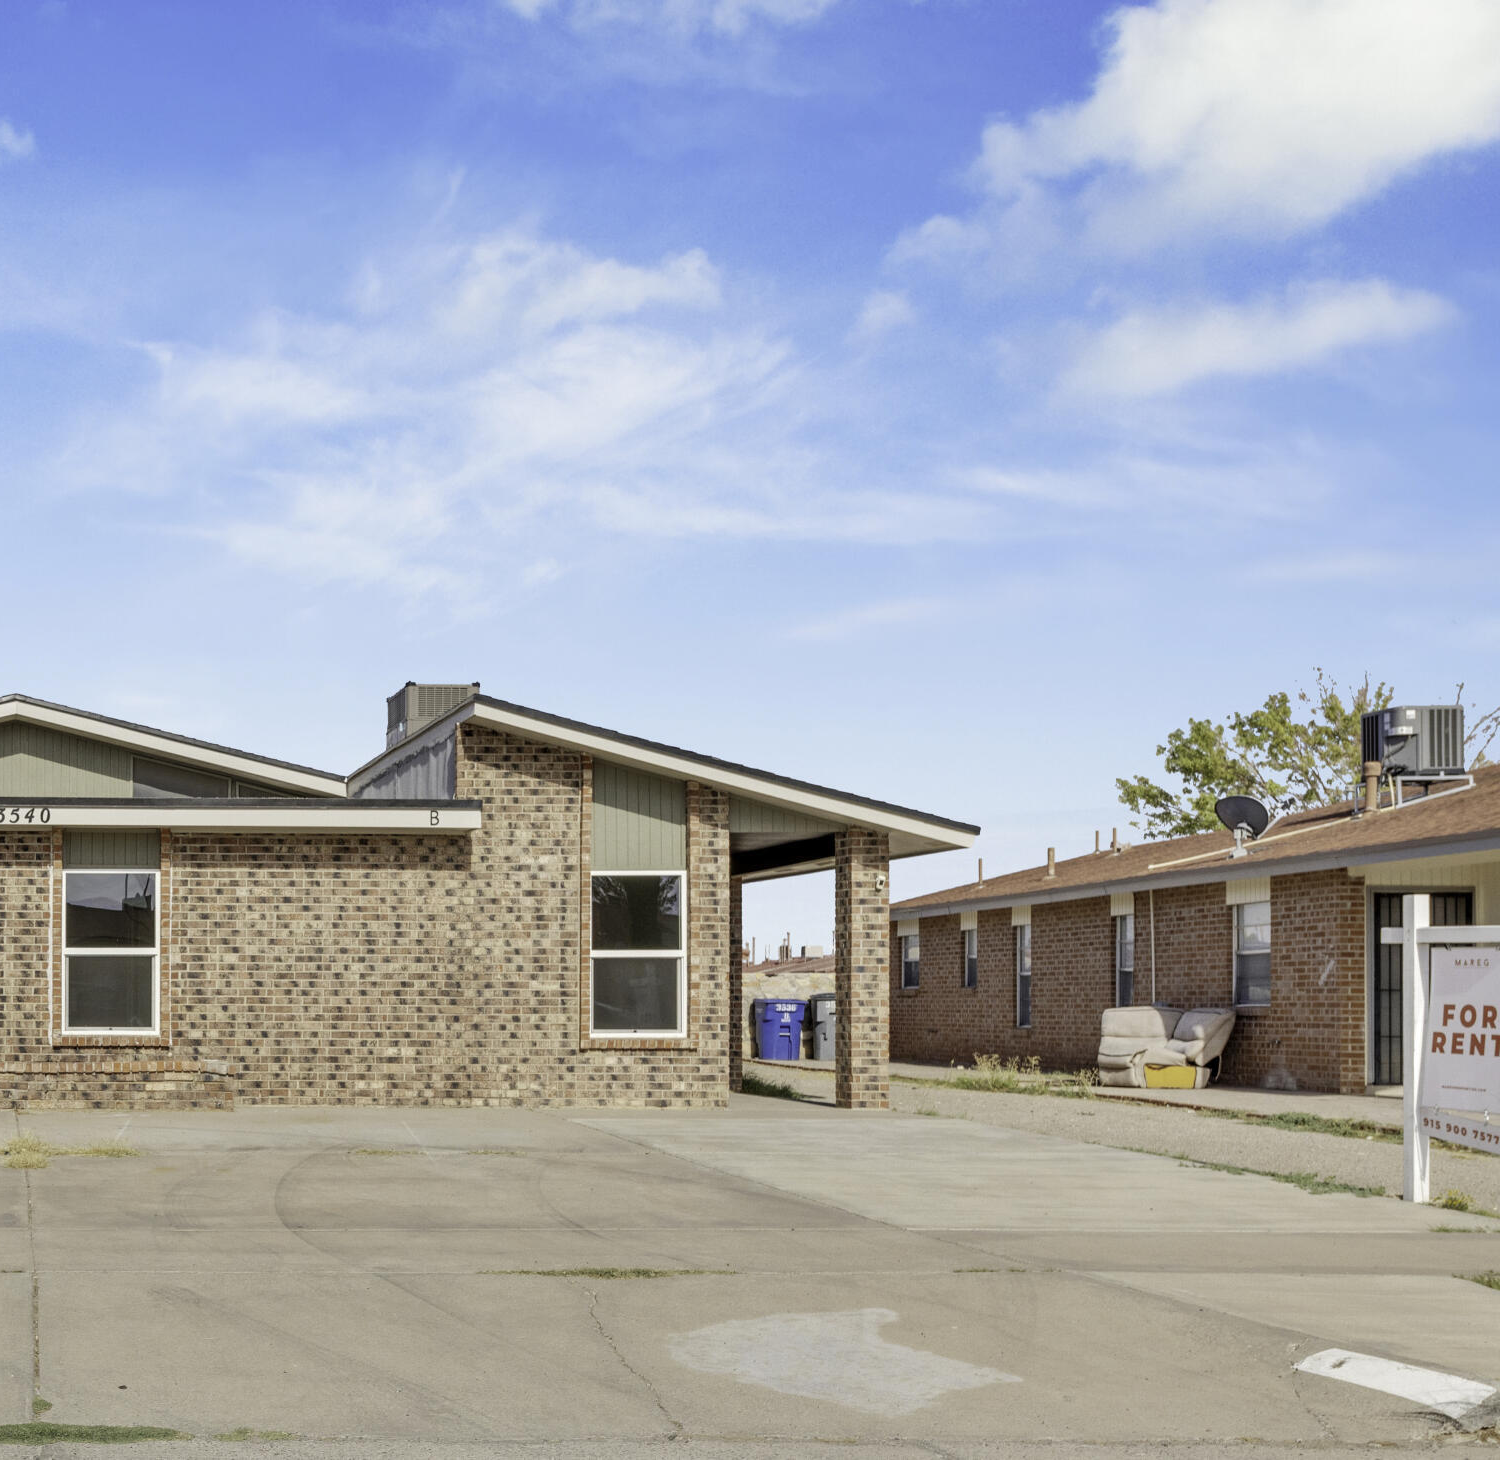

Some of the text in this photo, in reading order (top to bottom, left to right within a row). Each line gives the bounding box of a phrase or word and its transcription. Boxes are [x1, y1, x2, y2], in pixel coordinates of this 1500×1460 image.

[430, 810, 440, 826] B
[1442, 1003, 1498, 1029] FOR
[1431, 1031, 1500, 1057] RENT
[1423, 1116, 1500, 1145] 915 900 7577
